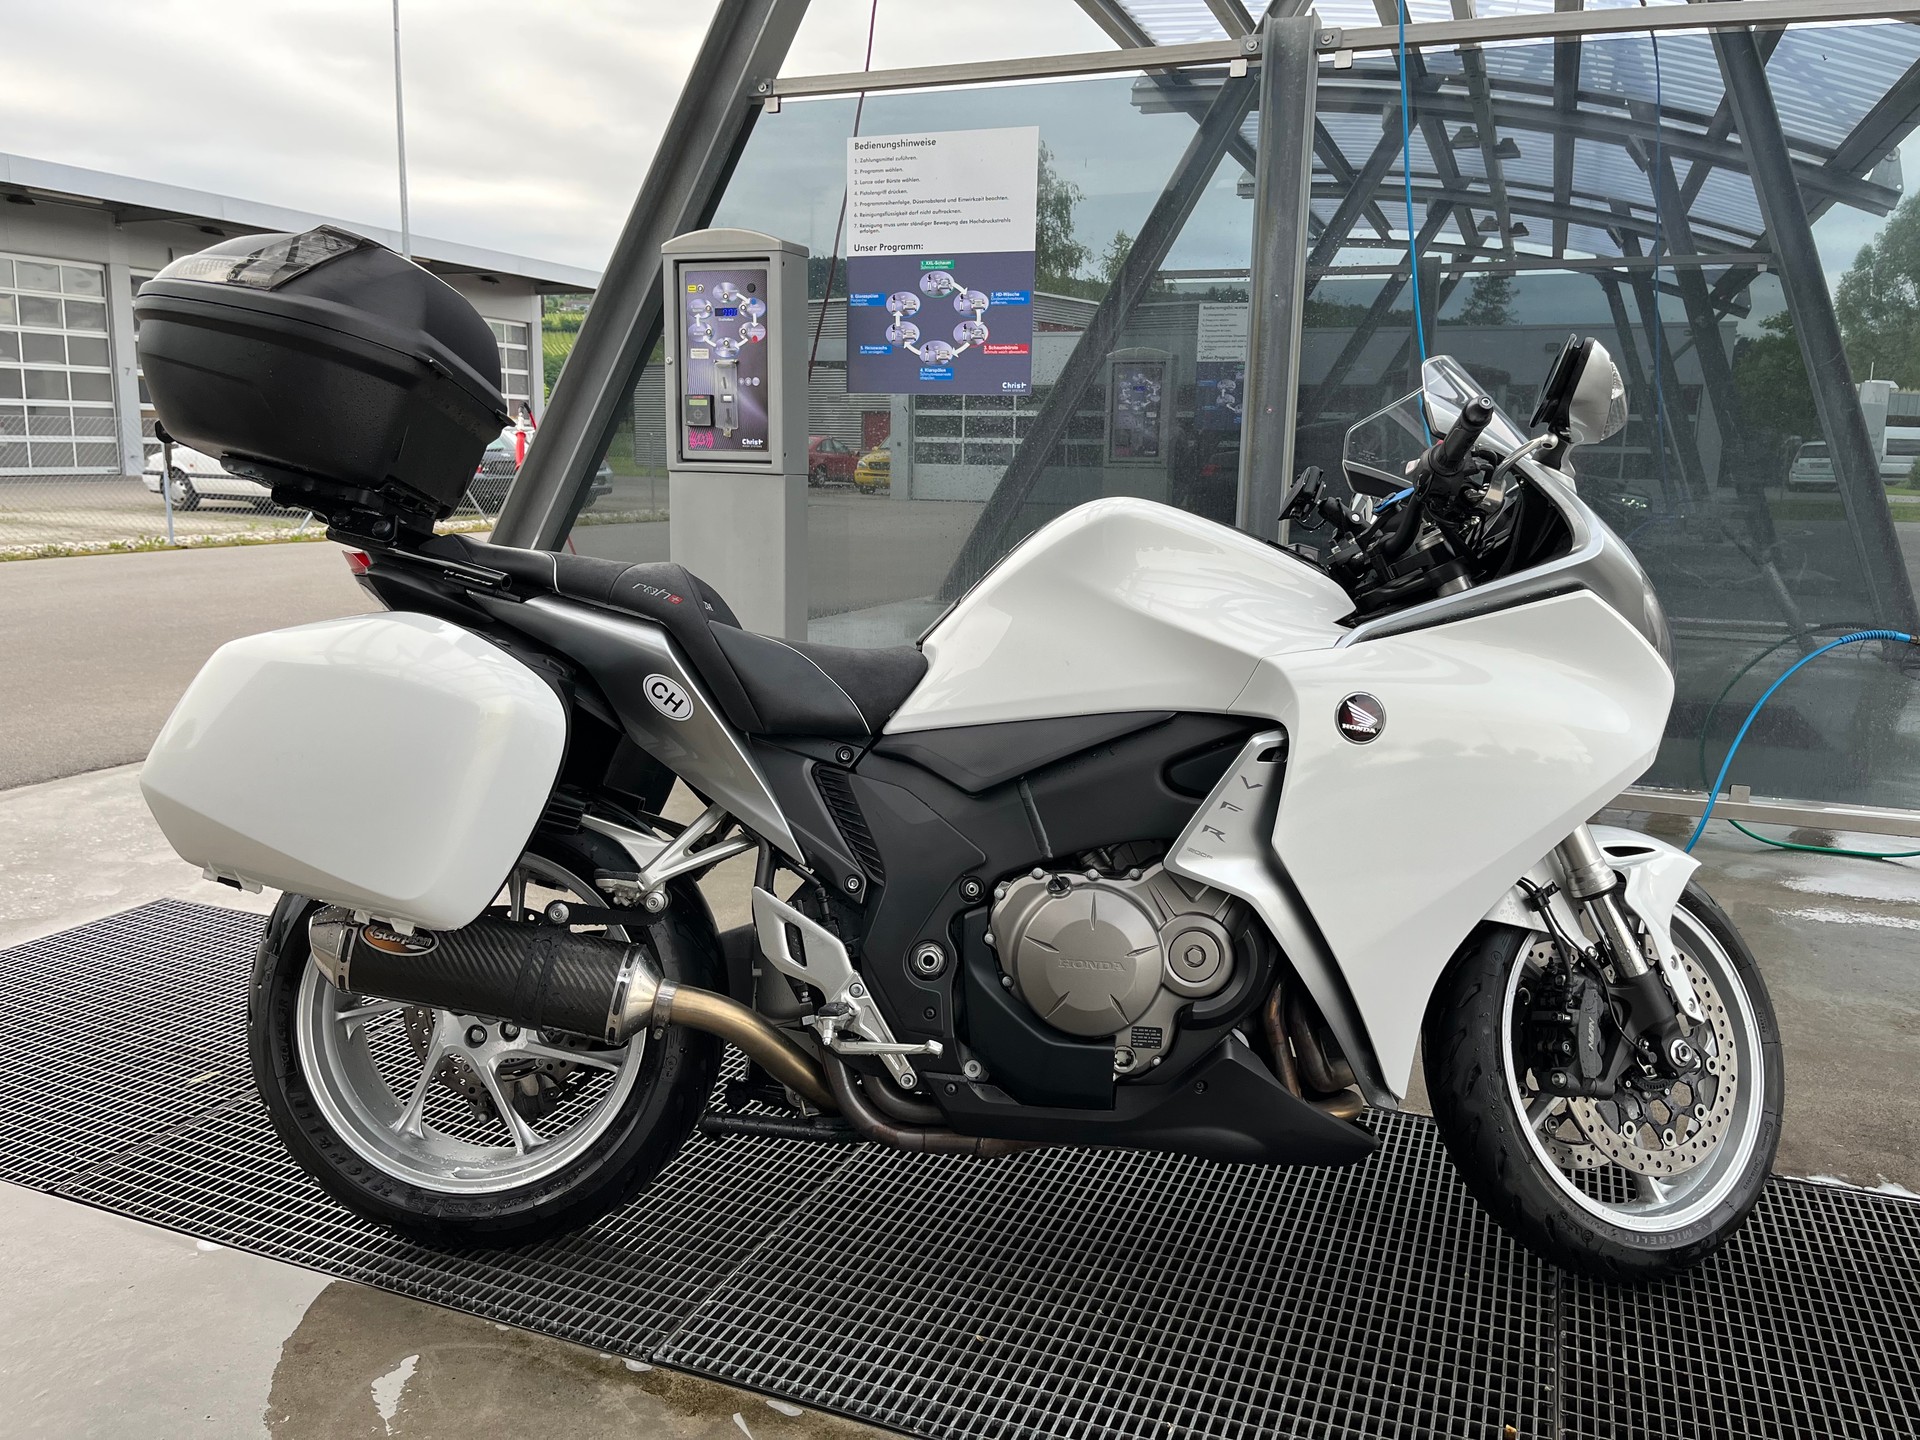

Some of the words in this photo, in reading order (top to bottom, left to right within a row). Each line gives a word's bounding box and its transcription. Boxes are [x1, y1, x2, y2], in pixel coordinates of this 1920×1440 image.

[854, 138, 937, 150] Bedienungshinweise
[853, 243, 877, 252] Unser
[879, 243, 924, 252] Programm:
[124, 367, 131, 376] 7
[651, 682, 684, 713] CH
[1342, 723, 1376, 734] HONDA
[1058, 959, 1127, 972] HONDA
[1625, 1230, 1693, 1244] MICHELIN
